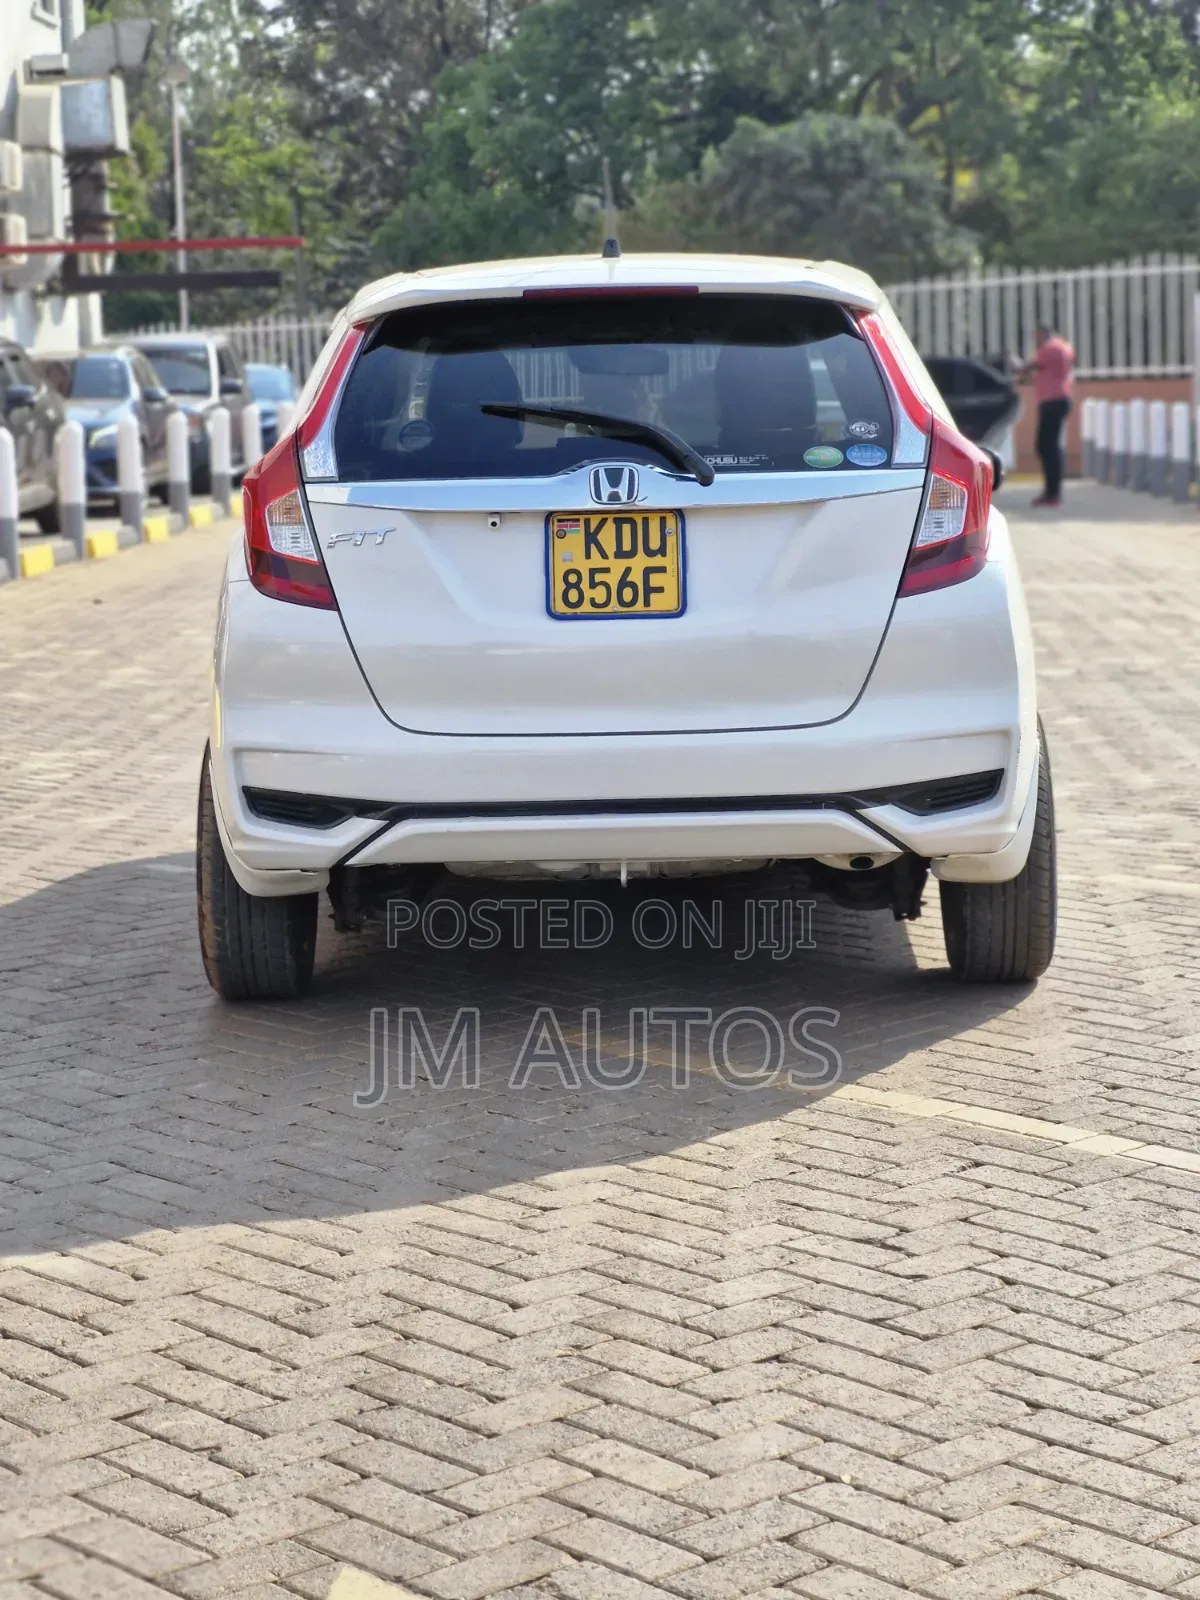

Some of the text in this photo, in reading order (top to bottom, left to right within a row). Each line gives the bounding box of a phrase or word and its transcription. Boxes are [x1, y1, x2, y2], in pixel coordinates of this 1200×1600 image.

[327, 527, 397, 549] FIT
[584, 516, 667, 560] KDU
[561, 566, 667, 609] 856F
